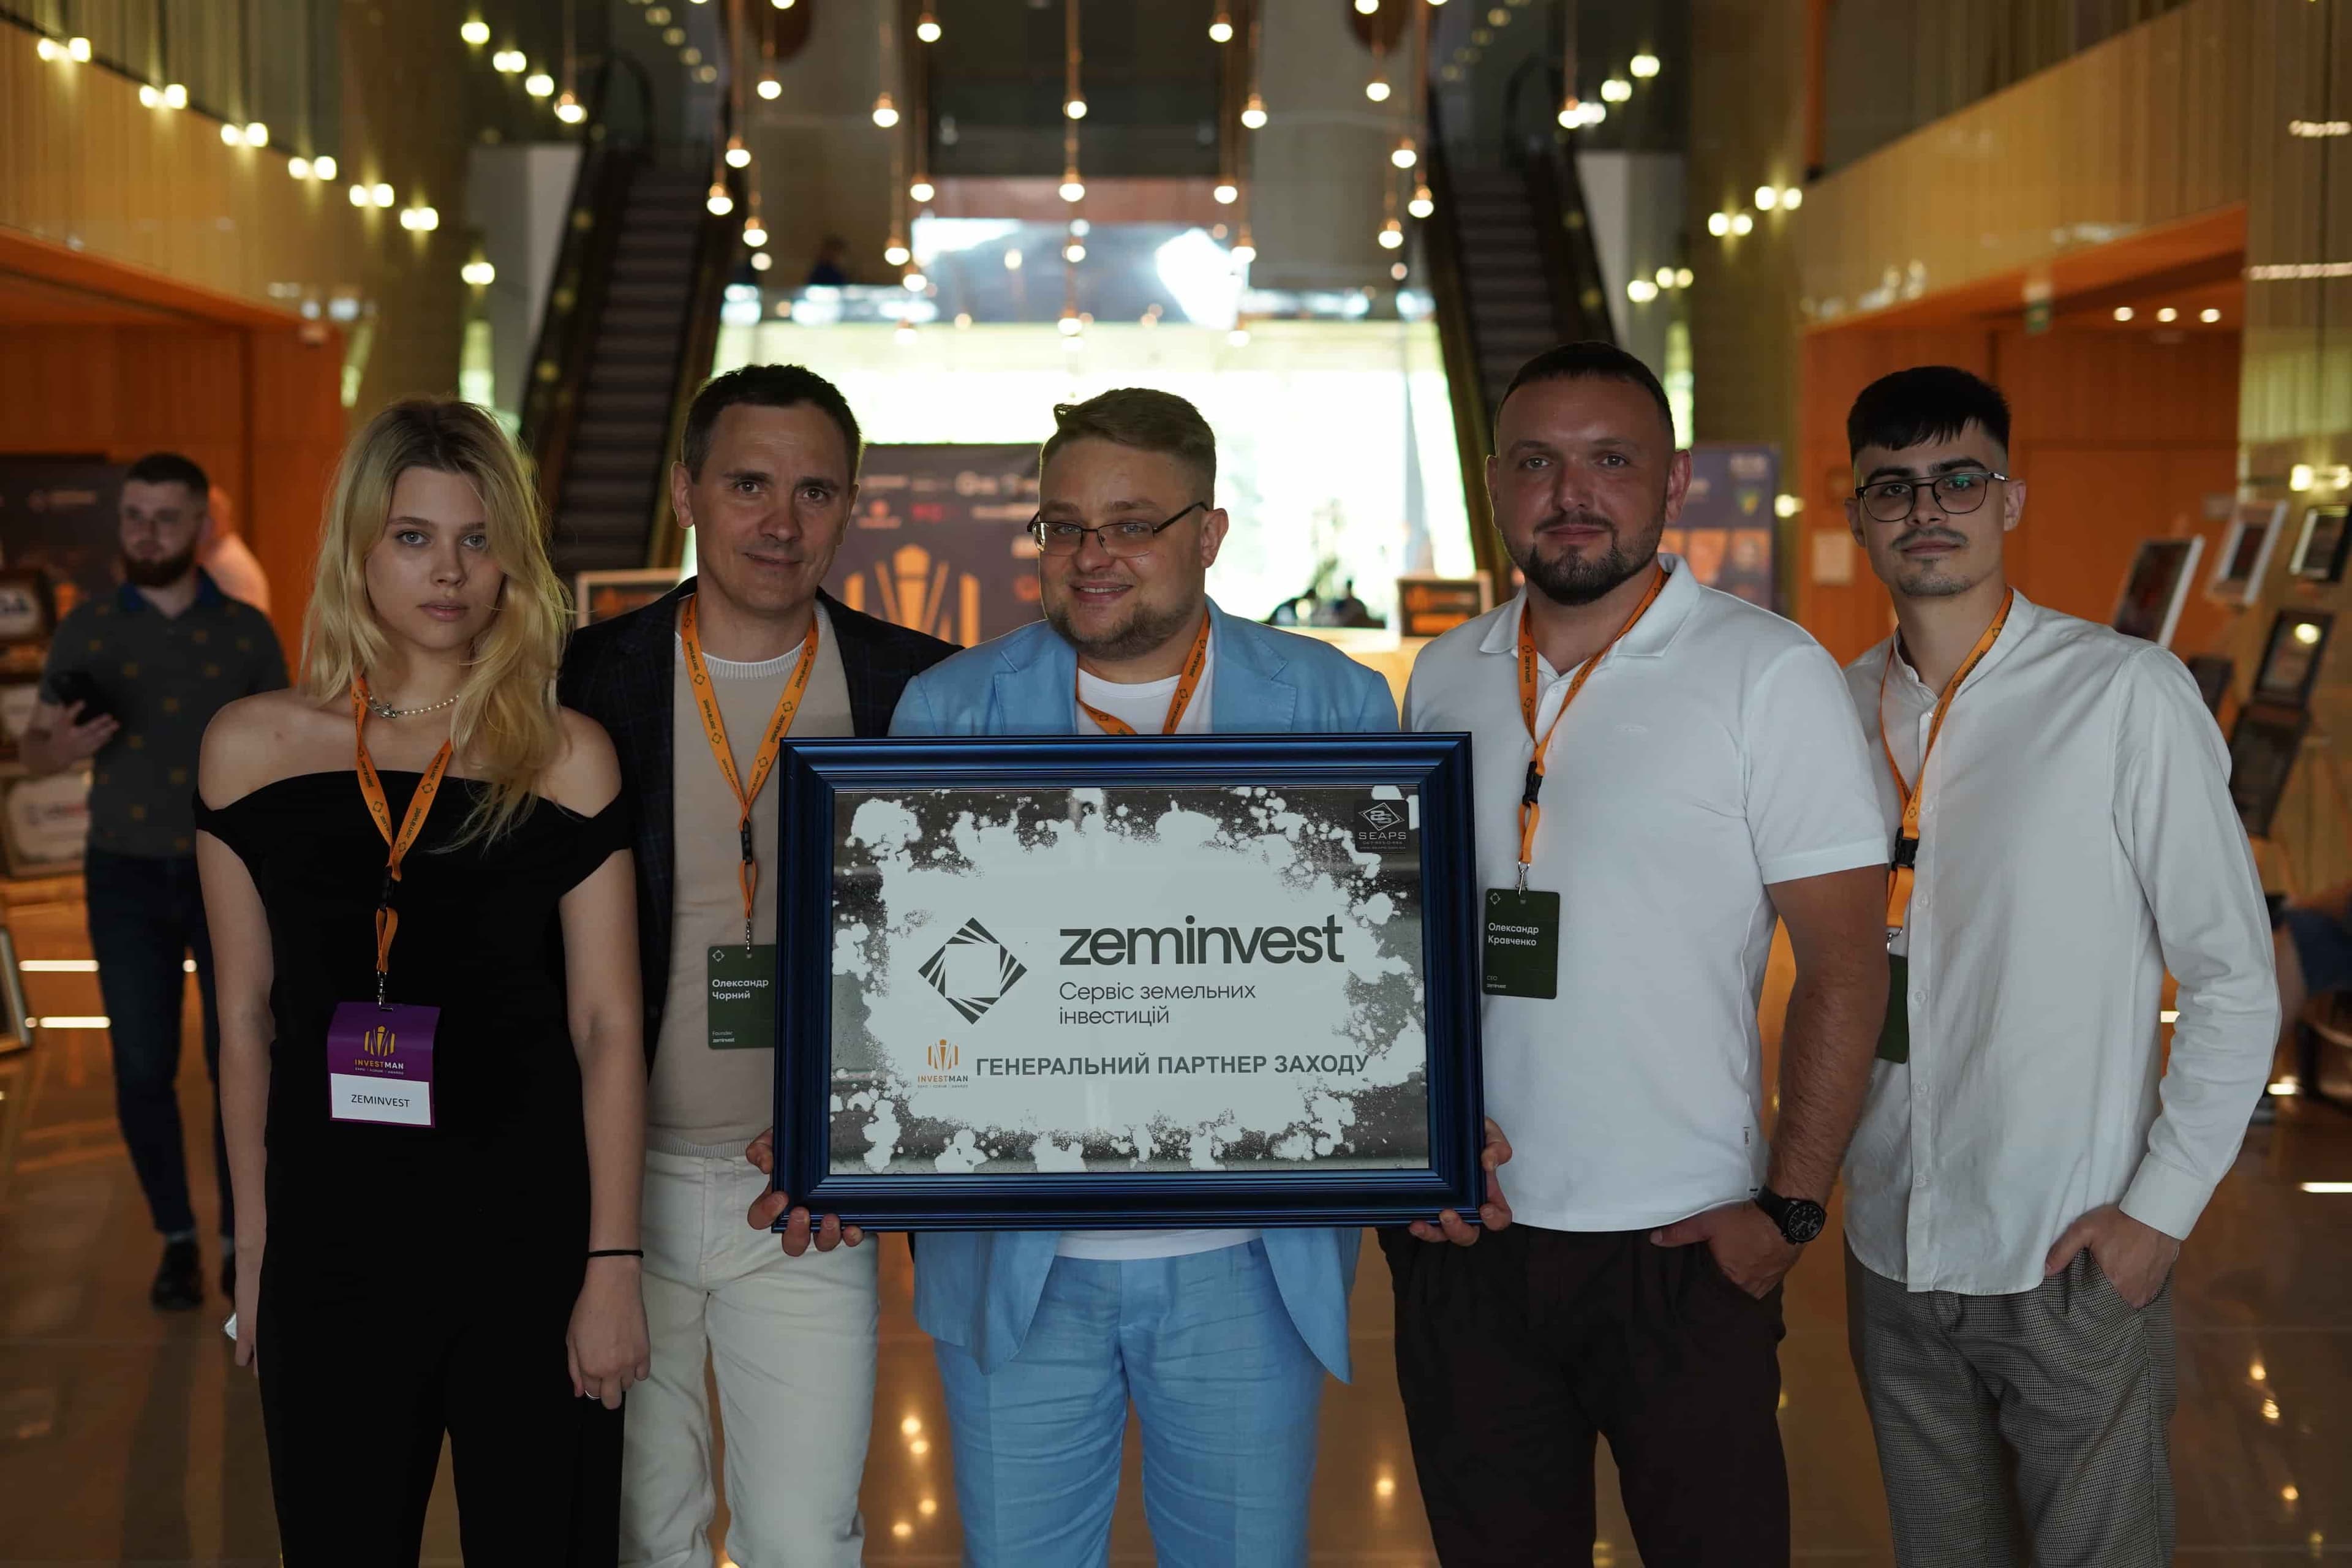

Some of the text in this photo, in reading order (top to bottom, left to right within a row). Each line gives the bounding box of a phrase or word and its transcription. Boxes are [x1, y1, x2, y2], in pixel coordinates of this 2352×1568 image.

[1488, 922, 1539, 935] Олександр
[1060, 914, 1344, 966] zeminvest
[1488, 935, 1537, 946] Кравченко
[712, 979, 769, 988] Олександр
[712, 990, 751, 1001] Чорний
[1060, 981, 1256, 1003] Сервіс земельних
[1060, 1003, 1169, 1027] інвестицій
[355, 1058, 404, 1070] INVESTMAN
[976, 1052, 1371, 1076] ГЕНЕРАЛЬНИЙ ПАРТНЕР ЗАХОДУ
[351, 1094, 410, 1108] ZEMINVEST
